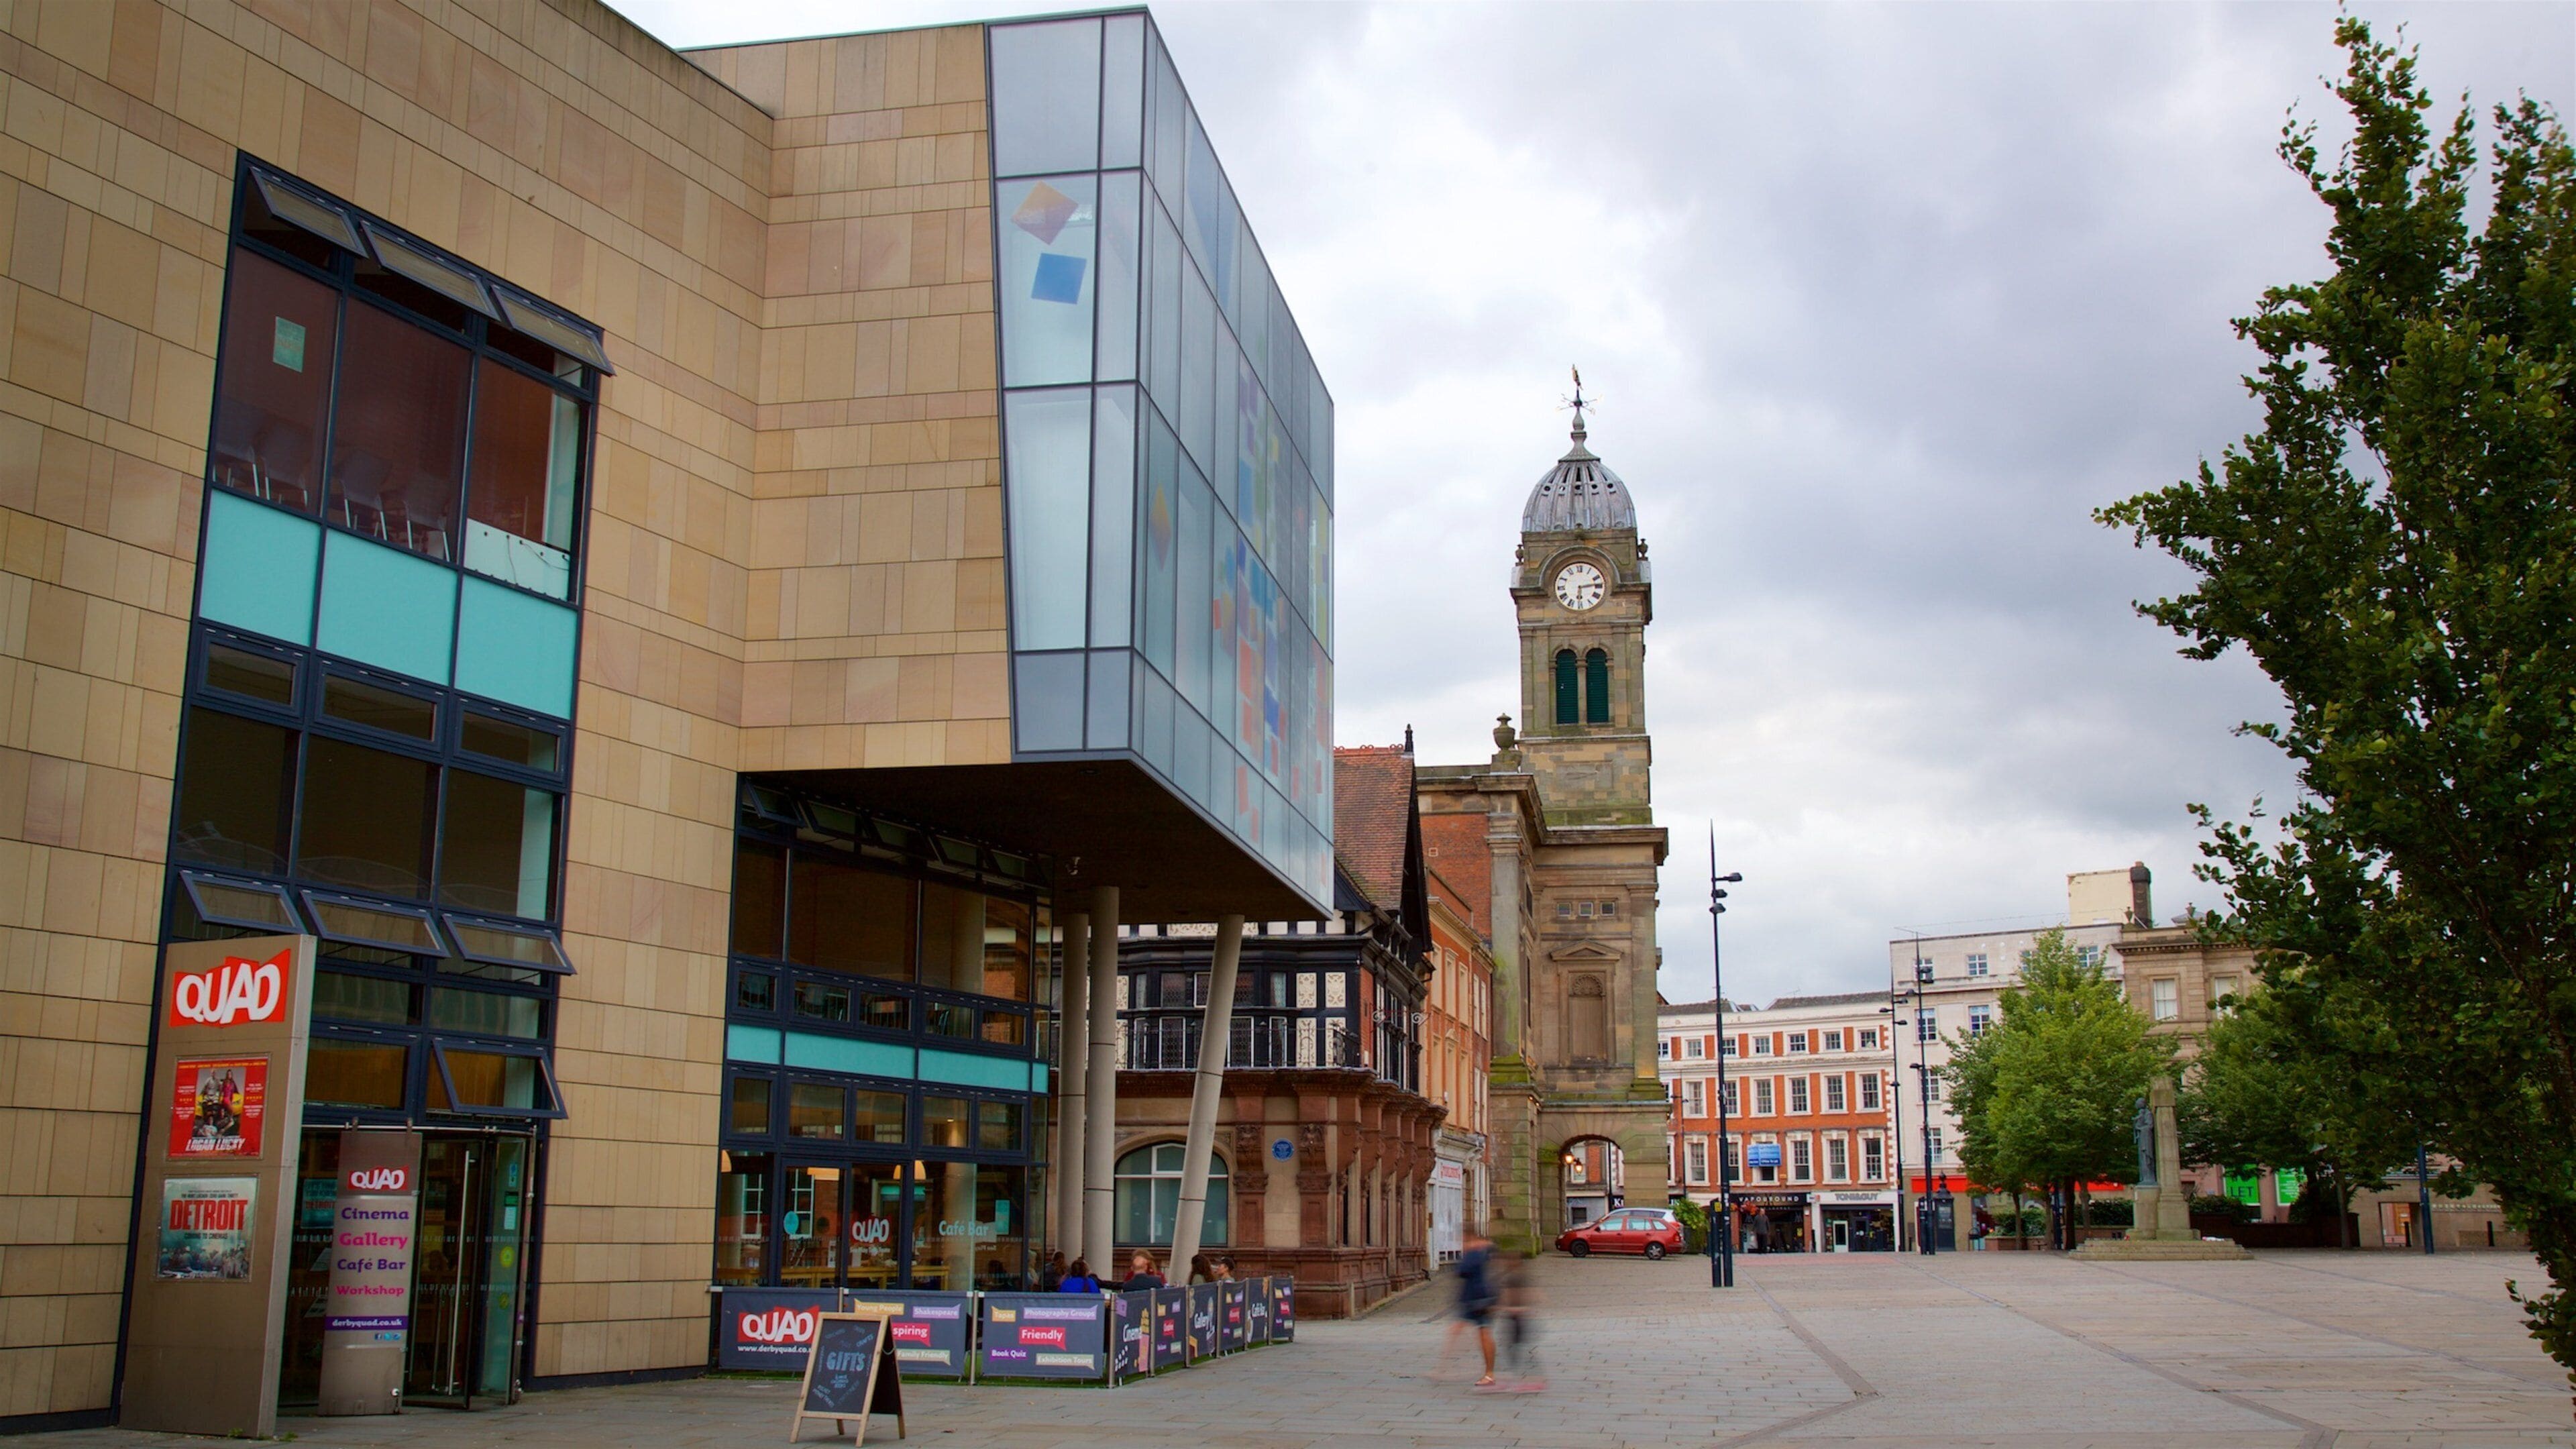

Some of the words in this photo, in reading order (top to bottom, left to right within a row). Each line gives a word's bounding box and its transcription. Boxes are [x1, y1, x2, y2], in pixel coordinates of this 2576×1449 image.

[176, 963, 280, 1024] QUAD
[185, 1138, 216, 1151] LOGAN
[215, 1137, 245, 1150] LUCKY
[351, 1169, 405, 1189] QUAD
[2231, 1186, 2253, 1198] LET
[169, 1199, 248, 1230] DETROIT
[341, 1208, 409, 1220] Cinema
[852, 1218, 890, 1243] QUAD
[968, 1221, 989, 1237] Bar
[339, 1232, 408, 1250] Gallery
[337, 1258, 373, 1273] Café
[378, 1259, 406, 1271] Bar
[335, 1285, 405, 1297] Workshop
[857, 1304, 878, 1313] Young
[879, 1304, 902, 1312] People
[914, 1307, 957, 1316] Shakespeare
[1025, 1309, 1069, 1318] Photography
[1071, 1309, 1095, 1318] Groups
[332, 1318, 402, 1328] derbyquad.co.uk
[742, 1310, 814, 1342] QUAD
[893, 1326, 928, 1338] spiring
[1022, 1329, 1063, 1342] Friendly
[738, 1344, 812, 1354] www.derbyquad.co.
[898, 1350, 919, 1359] Family
[921, 1350, 949, 1360] Friendly
[1010, 1350, 1026, 1358] Quiz
[826, 1352, 865, 1371] GIFTS
